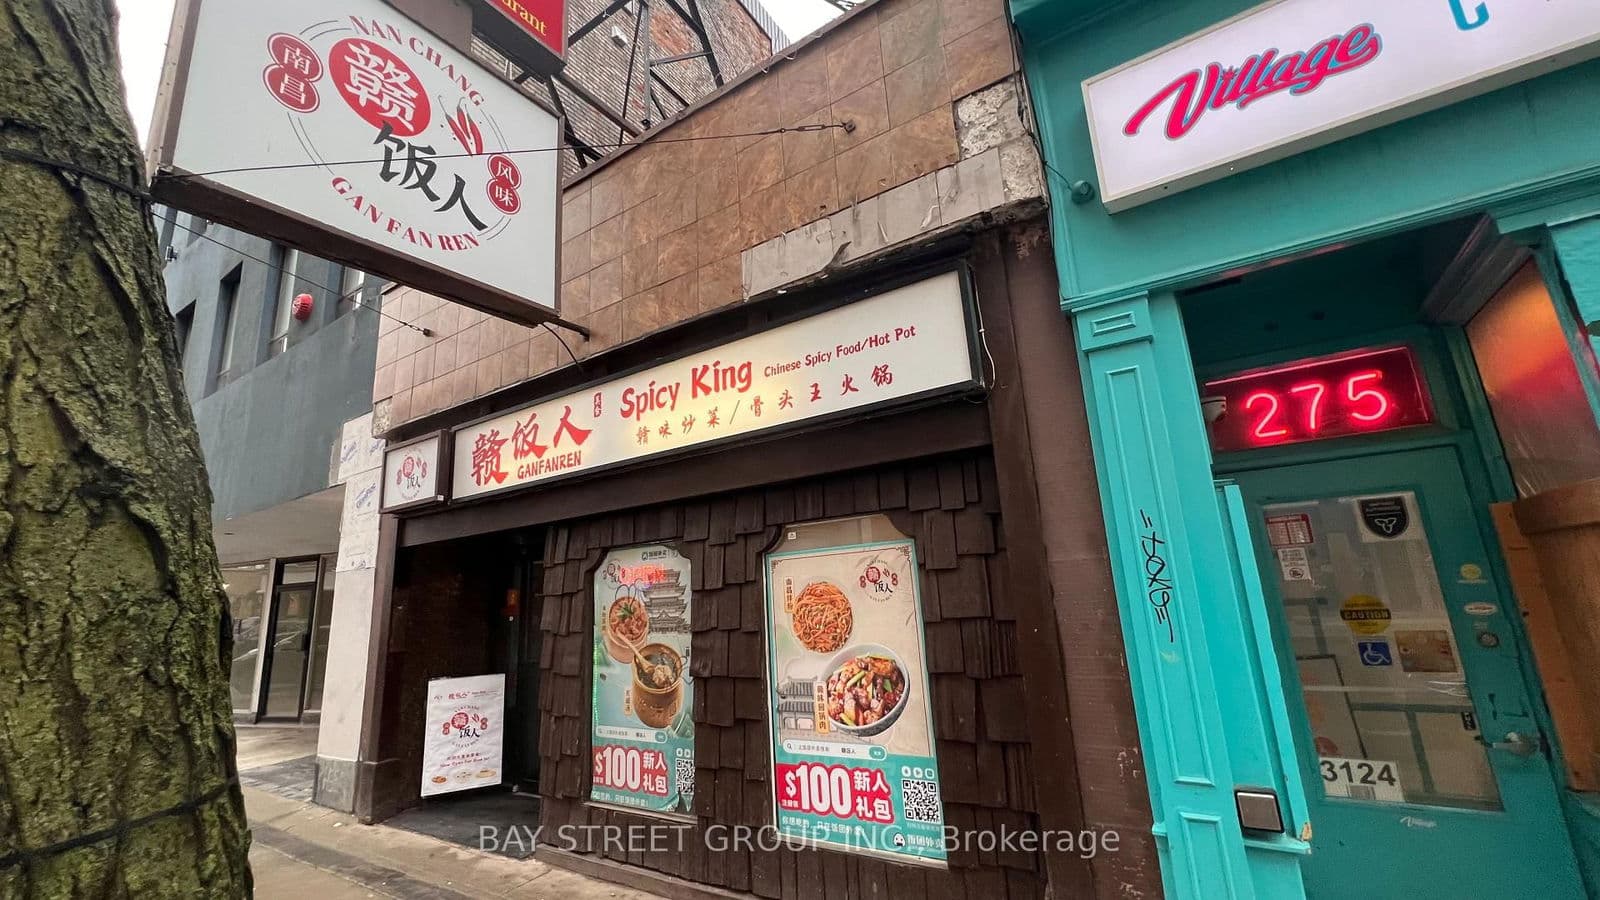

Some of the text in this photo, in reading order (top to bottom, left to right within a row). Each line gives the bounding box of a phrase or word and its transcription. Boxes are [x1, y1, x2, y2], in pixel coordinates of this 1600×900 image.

[281, 46, 312, 105] 南昌
[350, 16, 484, 106] NAN CHANG
[1123, 23, 1383, 139] Village
[494, 160, 515, 208] 风味
[332, 177, 480, 251] GAN FAN REN
[764, 325, 916, 378] Chinese Spicy Food/Hot Pot
[620, 380, 681, 421] Spicy
[691, 360, 752, 399] King
[1245, 370, 1388, 438] 275
[517, 450, 582, 480] GANFANREN
[1344, 609, 1389, 620] CAUTION
[595, 746, 641, 790] $100
[643, 752, 667, 771] 新人
[643, 773, 668, 793] 礼包
[853, 770, 889, 793] 新人
[1321, 760, 1396, 786] 3124
[785, 764, 852, 815] $100
[856, 796, 892, 821] 礼包
